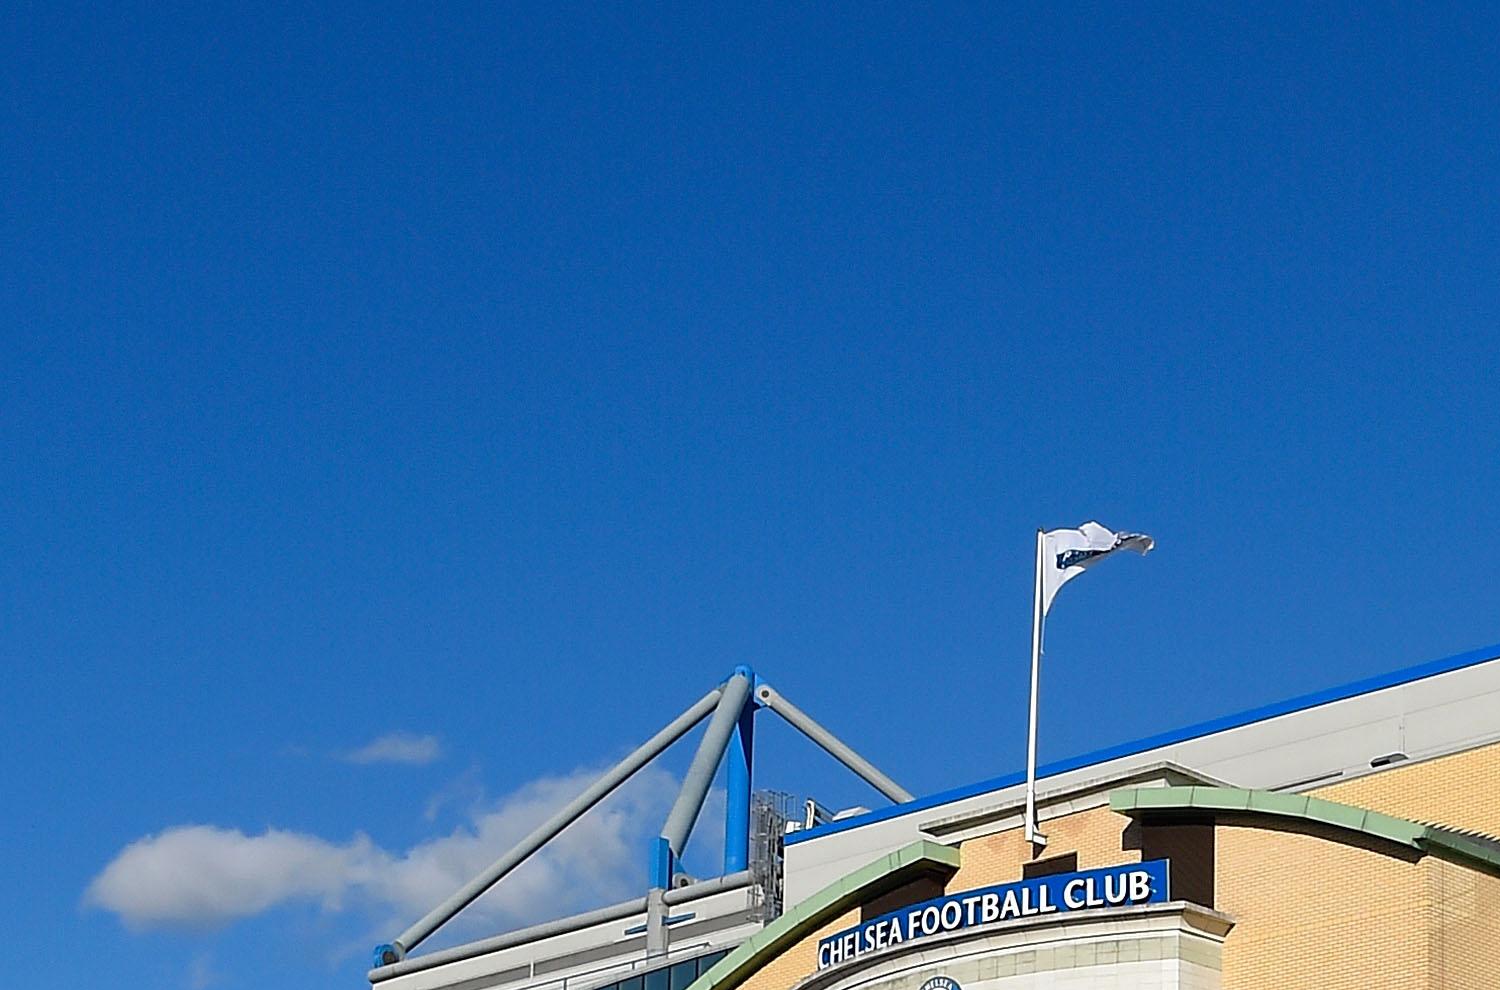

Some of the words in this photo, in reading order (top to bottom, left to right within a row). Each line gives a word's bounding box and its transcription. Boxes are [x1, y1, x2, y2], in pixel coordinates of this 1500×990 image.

[818, 917, 903, 970] CHELSEA
[908, 884, 1057, 940] FOOTBALL
[1063, 871, 1150, 908] CLUB
